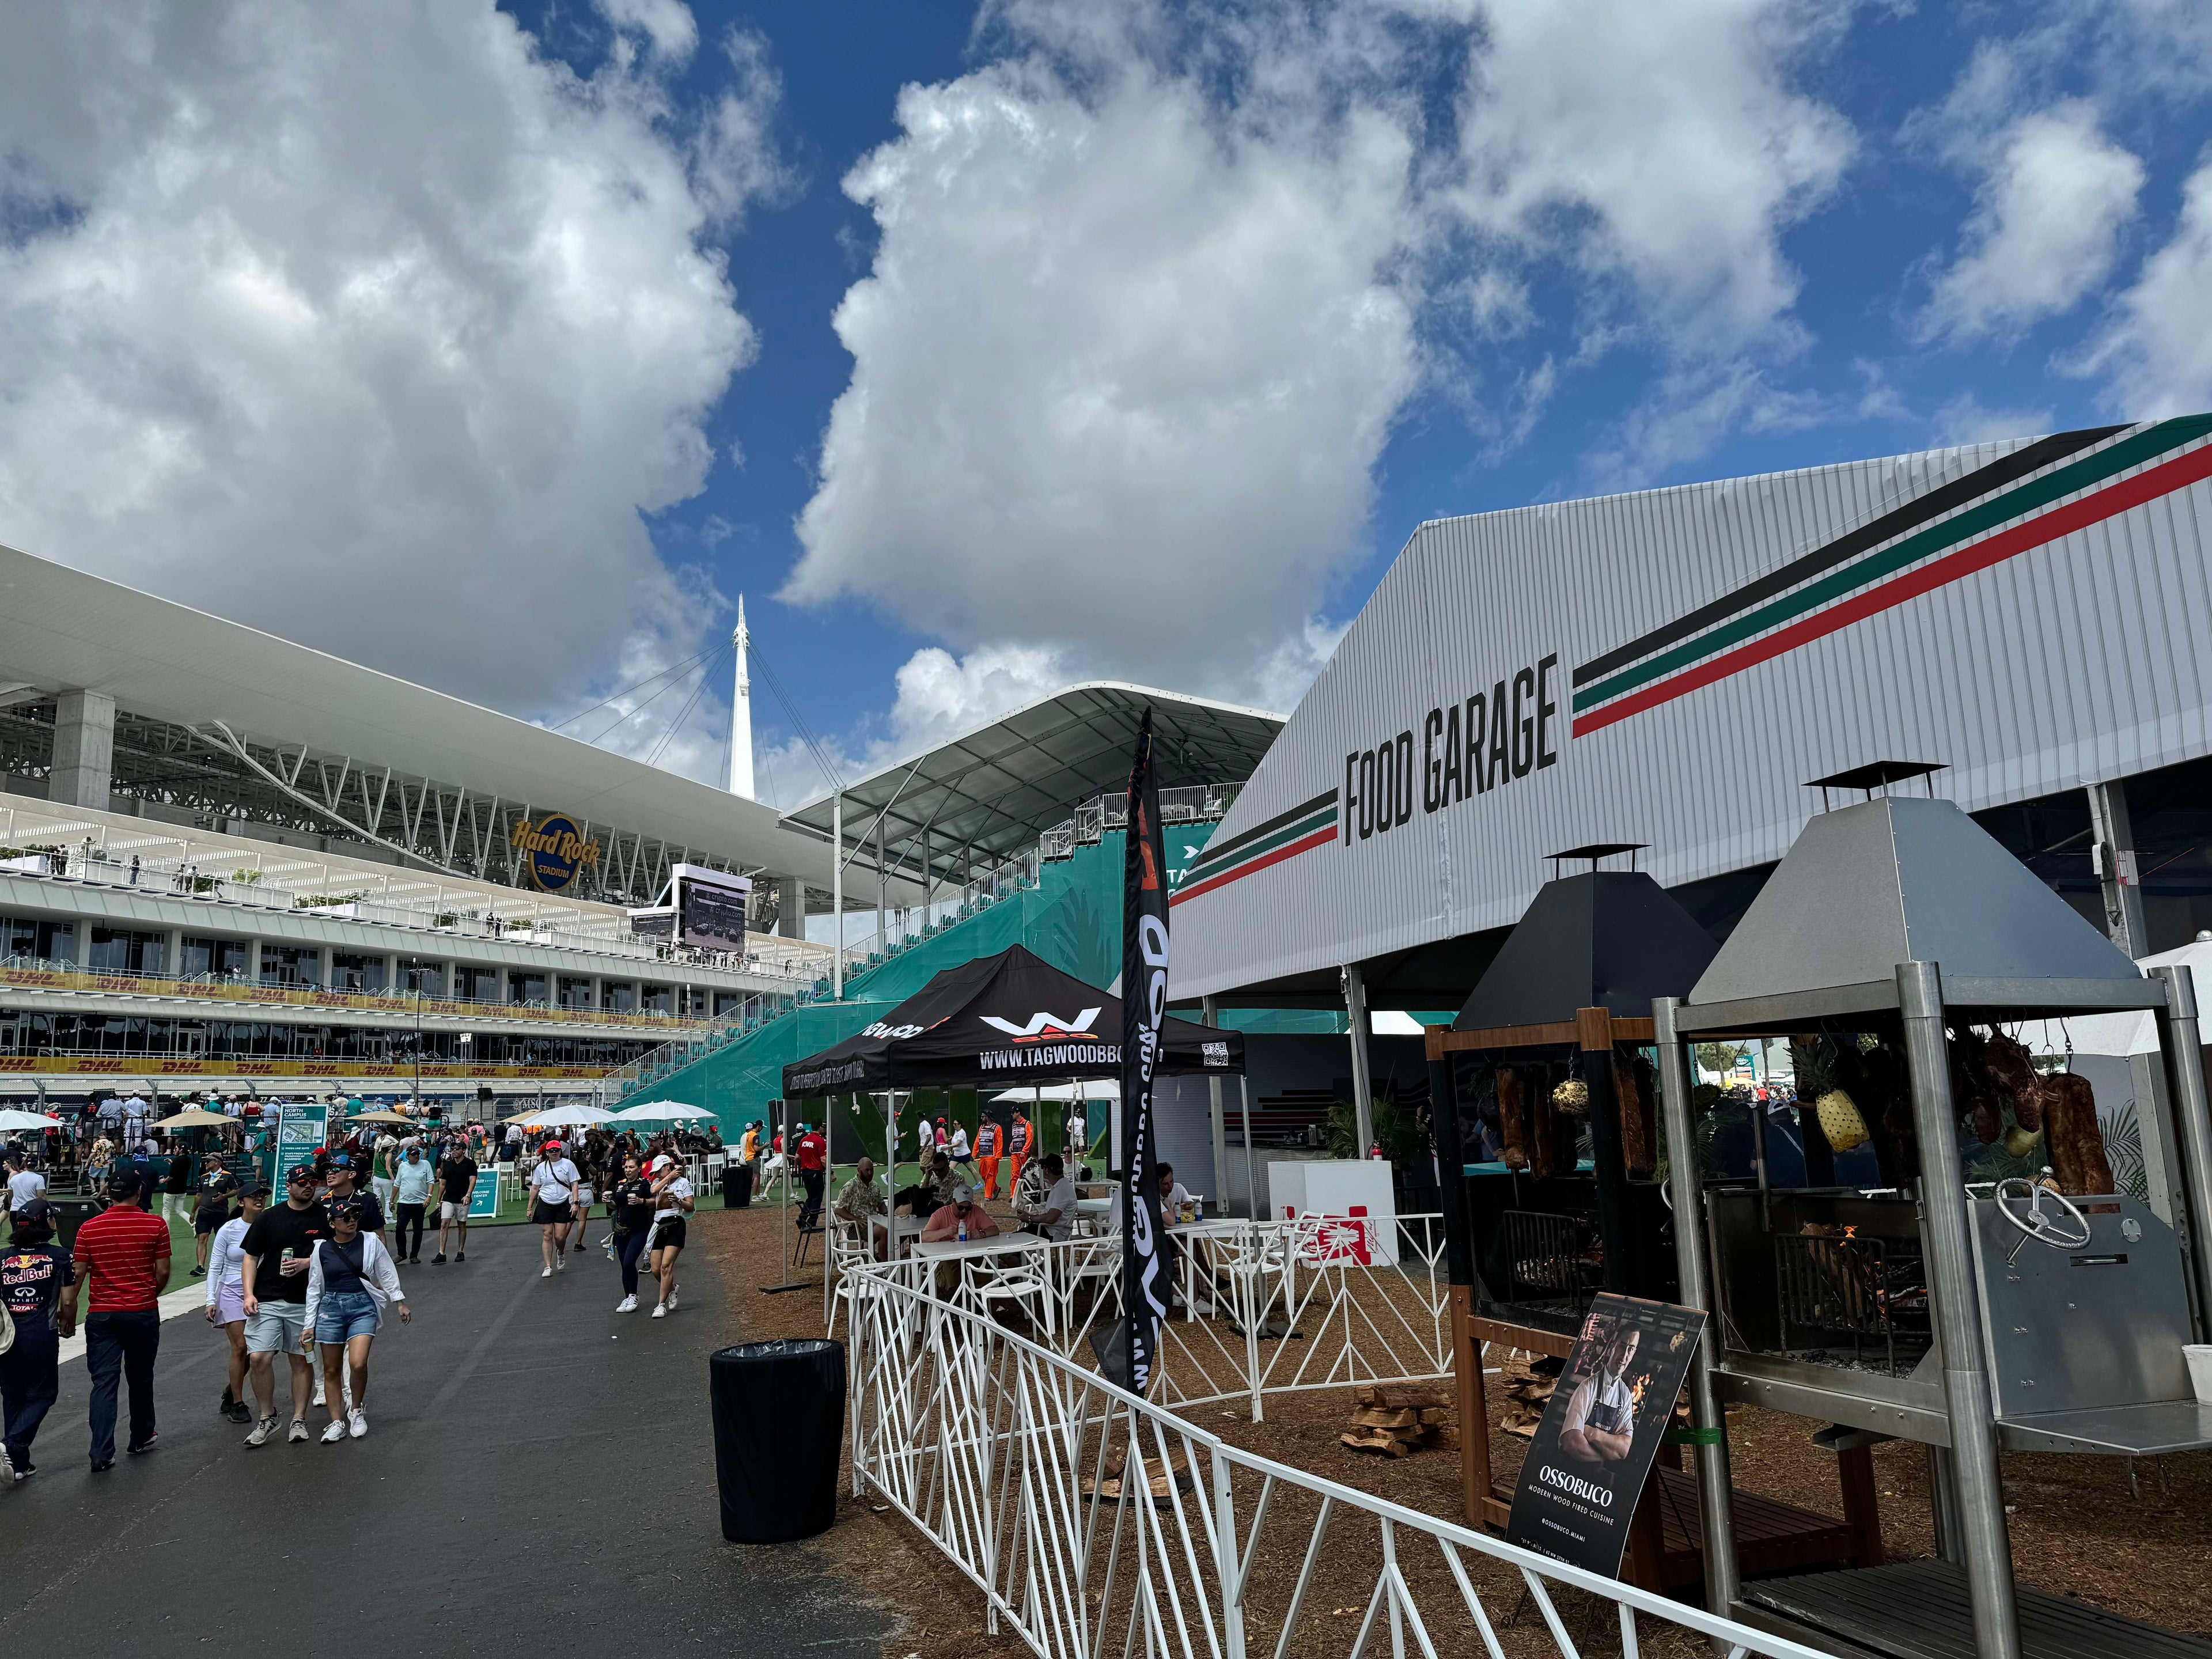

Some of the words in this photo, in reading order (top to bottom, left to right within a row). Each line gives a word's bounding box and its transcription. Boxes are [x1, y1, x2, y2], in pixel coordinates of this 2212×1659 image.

[1346, 730, 1413, 847] FOOD
[1424, 652, 1557, 814] GARAGE
[511, 821, 562, 855] Hard
[559, 831, 601, 869] Rock
[537, 865, 570, 879] STADIUM
[711, 894, 738, 905] crypto.com
[5, 971, 59, 986] DHL
[94, 977, 142, 993] DHL
[175, 984, 218, 997] DHL
[249, 989, 287, 1001] DHL
[314, 994, 350, 1006] DHL
[376, 998, 407, 1010] DHL
[429, 1002, 459, 1013] DHL
[480, 1006, 506, 1016] DHL
[525, 1010, 551, 1019] DHL
[77, 1060, 126, 1072] DHL
[161, 1062, 202, 1073] DHL
[235, 1063, 274, 1074] DHL
[302, 1065, 339, 1074] DHL
[364, 1066, 397, 1075] DHL
[420, 1067, 449, 1076] DHL
[470, 1067, 498, 1076] DHL
[517, 1068, 542, 1077] DHL
[561, 1069, 584, 1077] DHL
[2, 1268, 26, 1285] Red
[26, 1264, 53, 1282] Bull
[1539, 1465, 1613, 1507] OSSOBUCO
[1528, 1484, 1551, 1499] MODERN
[1553, 1494, 1570, 1506] WOOD
[1572, 1502, 1588, 1514] FIRED
[1590, 1510, 1614, 1526] CUISINE
[1541, 1518, 1585, 1543] @OSSOBUCO.MIAMI
